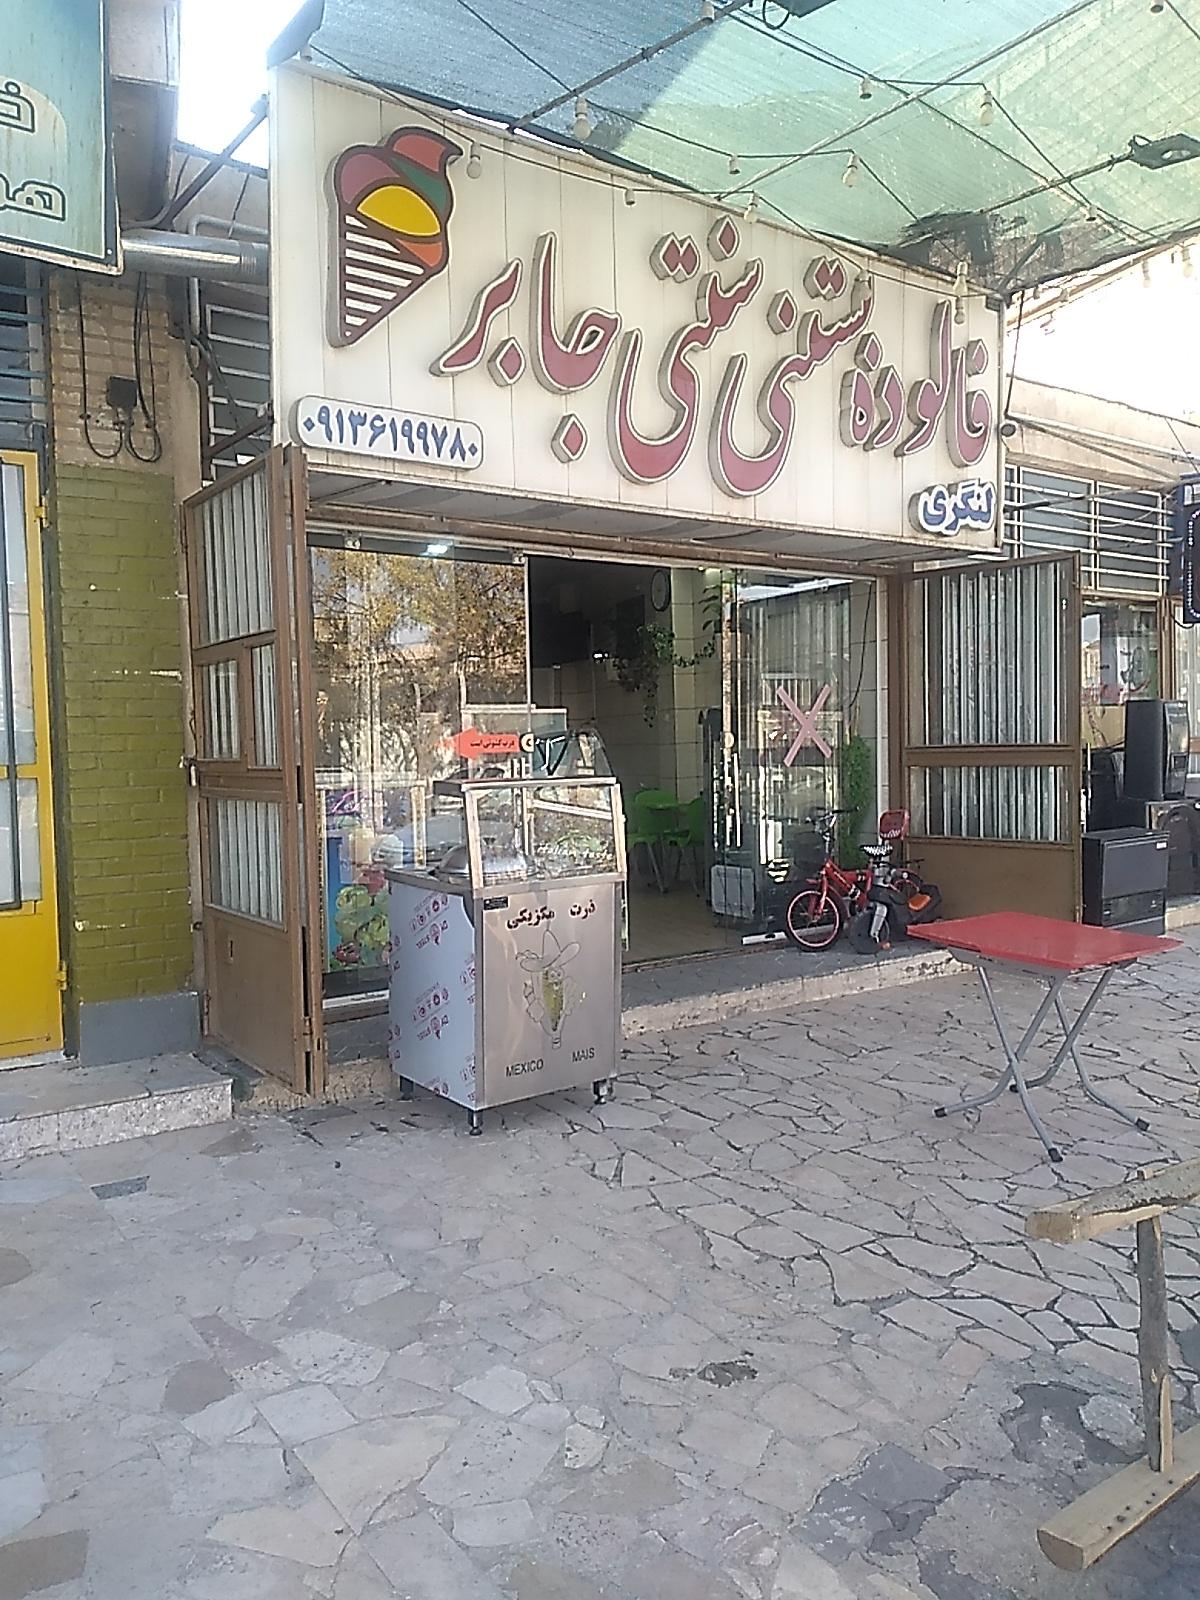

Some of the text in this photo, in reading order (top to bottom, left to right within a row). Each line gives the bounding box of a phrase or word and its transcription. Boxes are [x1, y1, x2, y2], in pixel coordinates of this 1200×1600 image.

[434, 214, 992, 497] فالوده بستنی سنتی جابر
[302, 404, 478, 463] ۰۹۱۳۶۱۹۹۷۸۰
[917, 480, 996, 536] لنگری
[506, 899, 596, 930] ذرت مکزیکی
[505, 1047, 595, 1077] MEXICO MAIS
